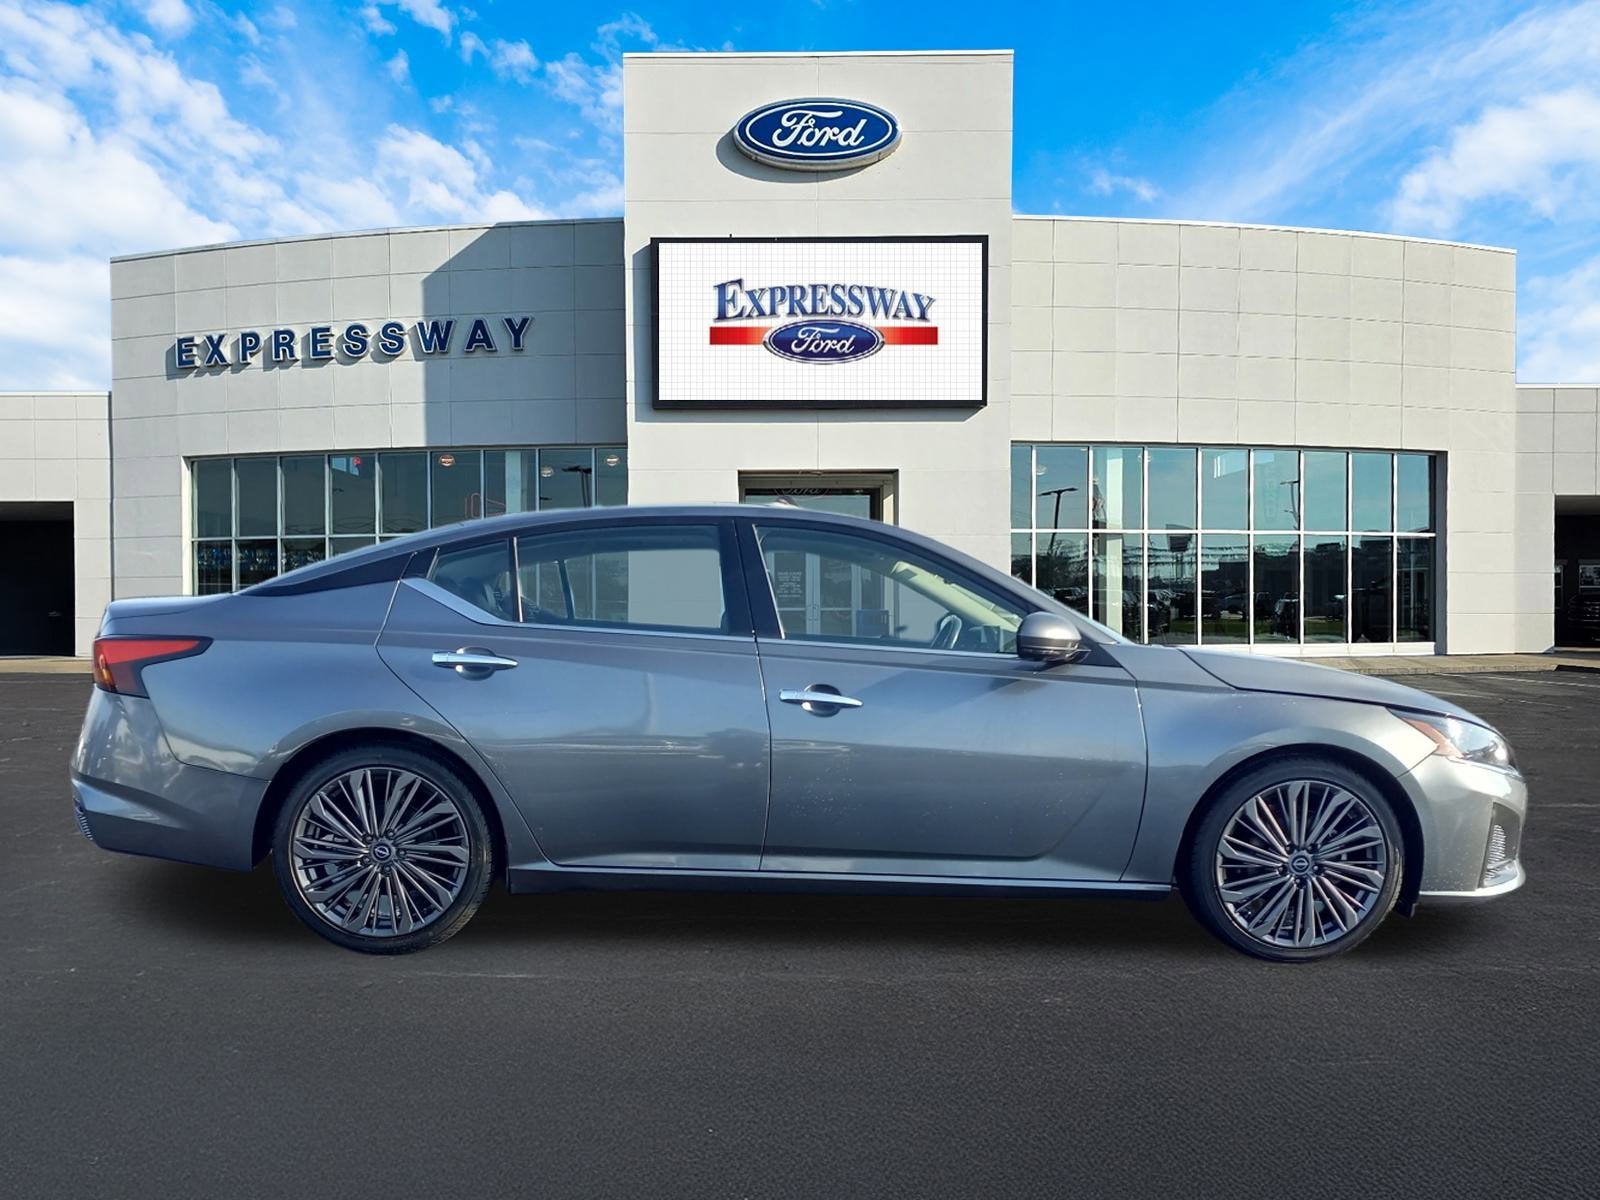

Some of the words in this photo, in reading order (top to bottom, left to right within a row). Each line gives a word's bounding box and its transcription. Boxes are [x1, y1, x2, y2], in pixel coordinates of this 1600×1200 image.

[771, 109, 867, 148] Ford
[712, 278, 936, 322] EXPRESSWAY
[174, 316, 533, 369] EXPRESSWAY
[790, 326, 856, 354] Ford
